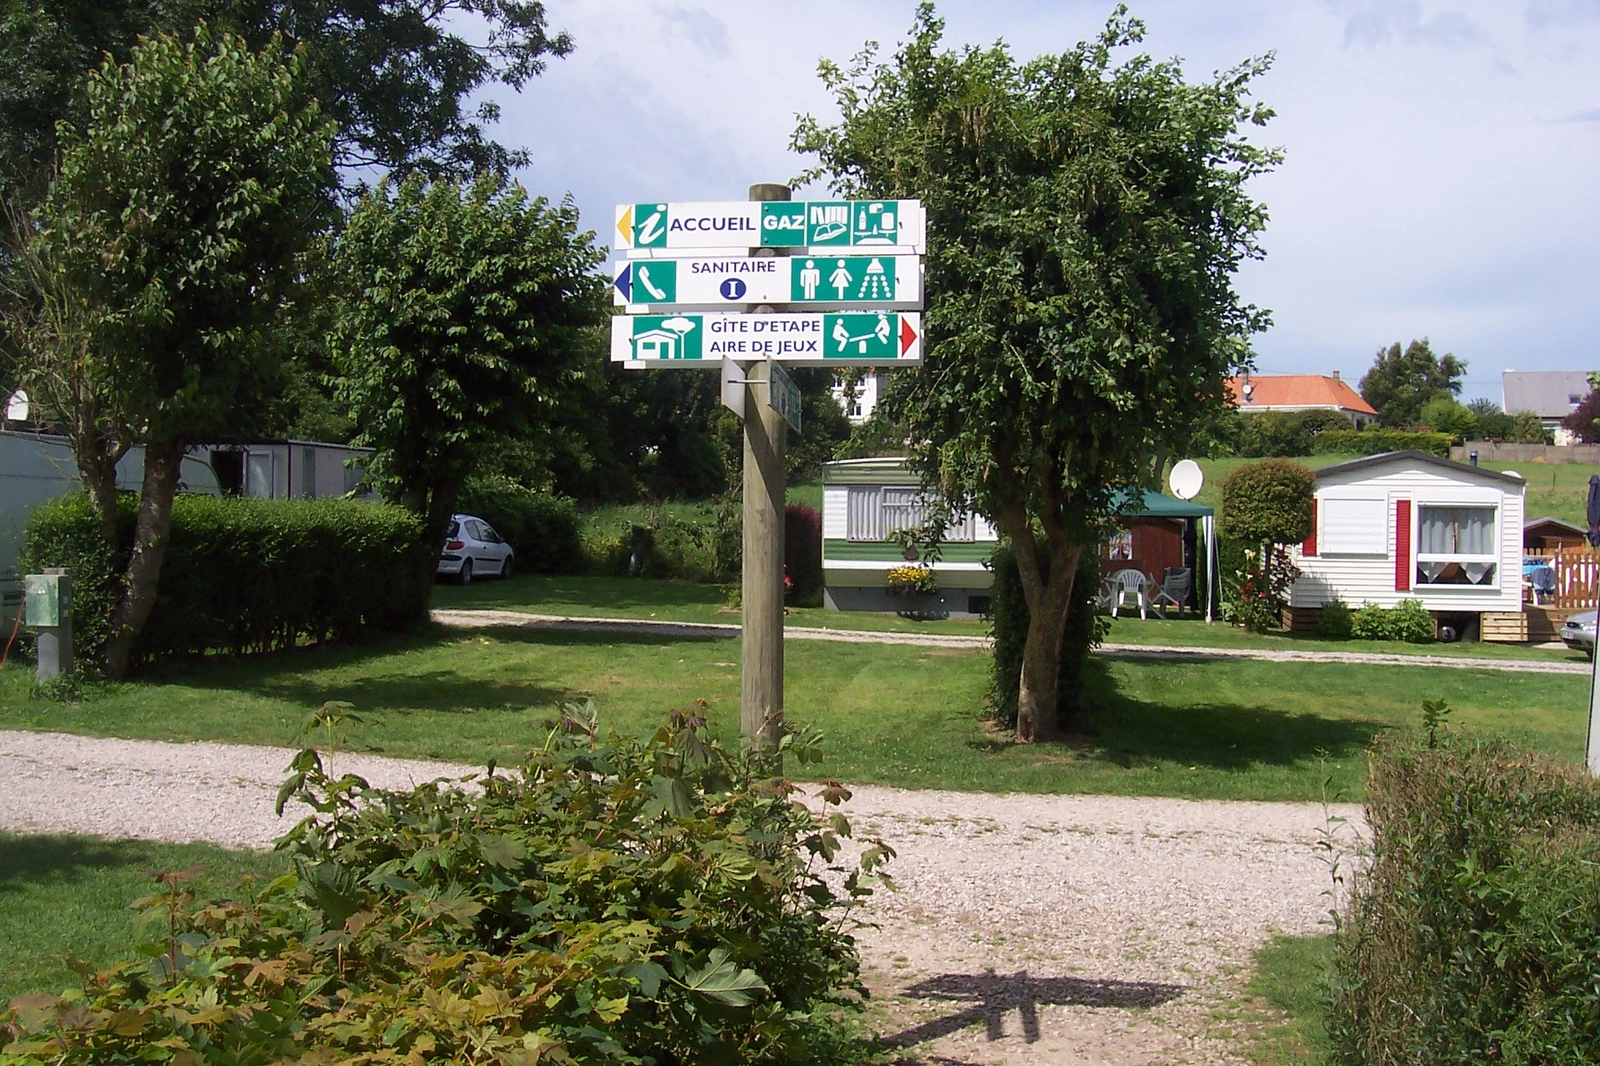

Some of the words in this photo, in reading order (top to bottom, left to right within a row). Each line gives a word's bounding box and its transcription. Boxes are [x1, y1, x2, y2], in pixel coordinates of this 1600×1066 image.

[669, 217, 757, 232] ACCUEIL
[763, 215, 805, 231] GAZ
[691, 261, 776, 274] SANITAIRE
[711, 318, 748, 333] GÎTE
[753, 320, 821, 333] D'ETAPE
[710, 341, 747, 353] AIRE
[752, 340, 773, 353] DE
[776, 340, 818, 355] JEUX
